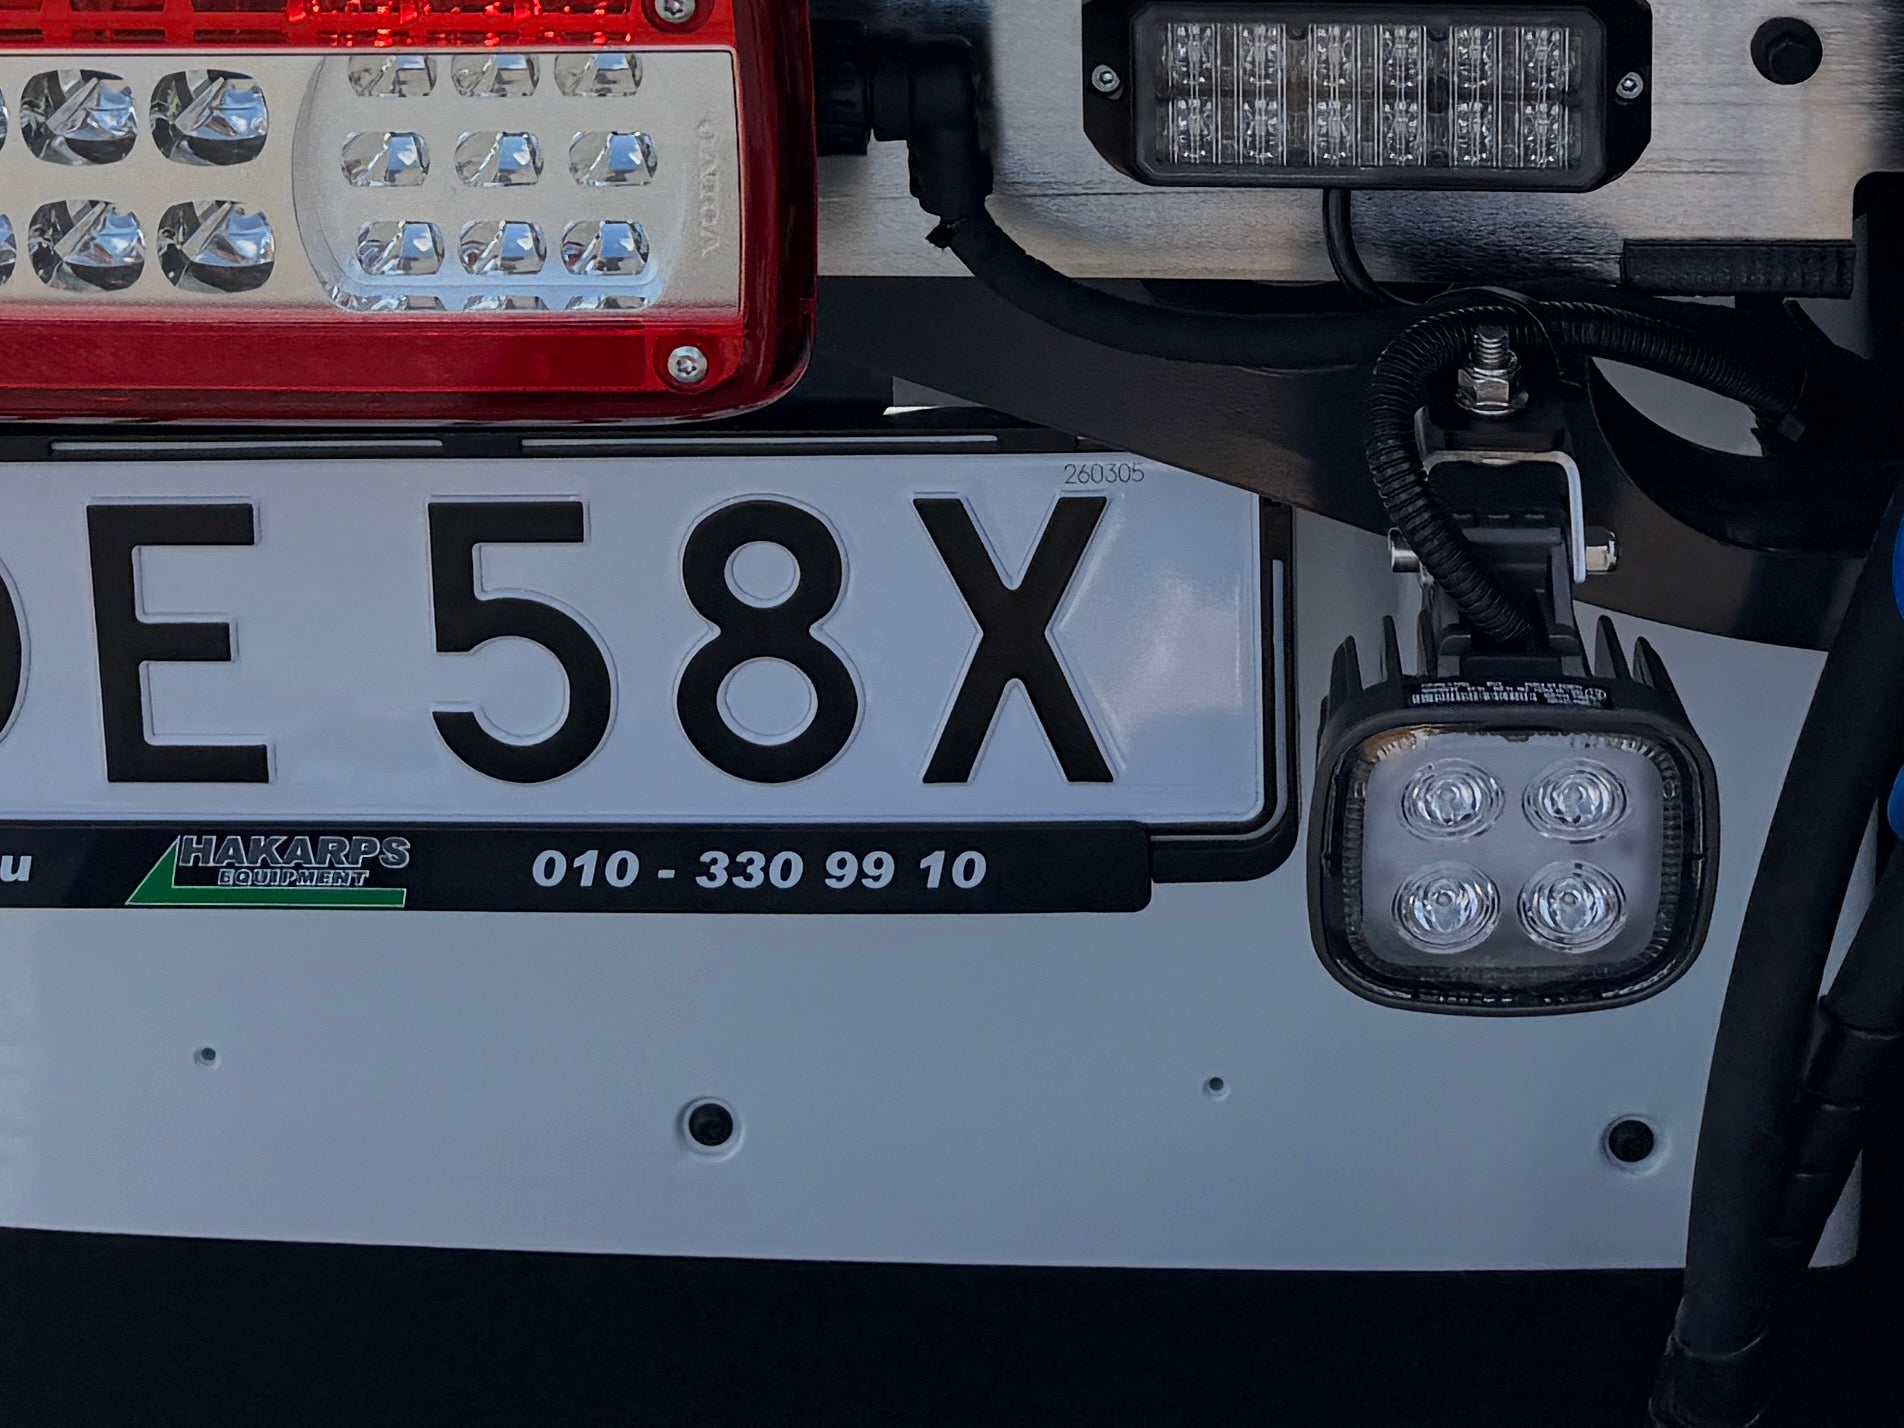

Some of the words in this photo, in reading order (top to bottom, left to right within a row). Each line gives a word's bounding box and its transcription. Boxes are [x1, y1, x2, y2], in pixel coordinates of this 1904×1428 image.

[1063, 463, 1145, 484] 260305
[427, 497, 1114, 784] 58X
[179, 835, 410, 868] HAKARPS
[218, 868, 369, 887] EQUIPMENT
[532, 849, 640, 889] 010
[696, 850, 804, 889] 330
[824, 850, 895, 889] 99
[919, 850, 987, 889] 10
